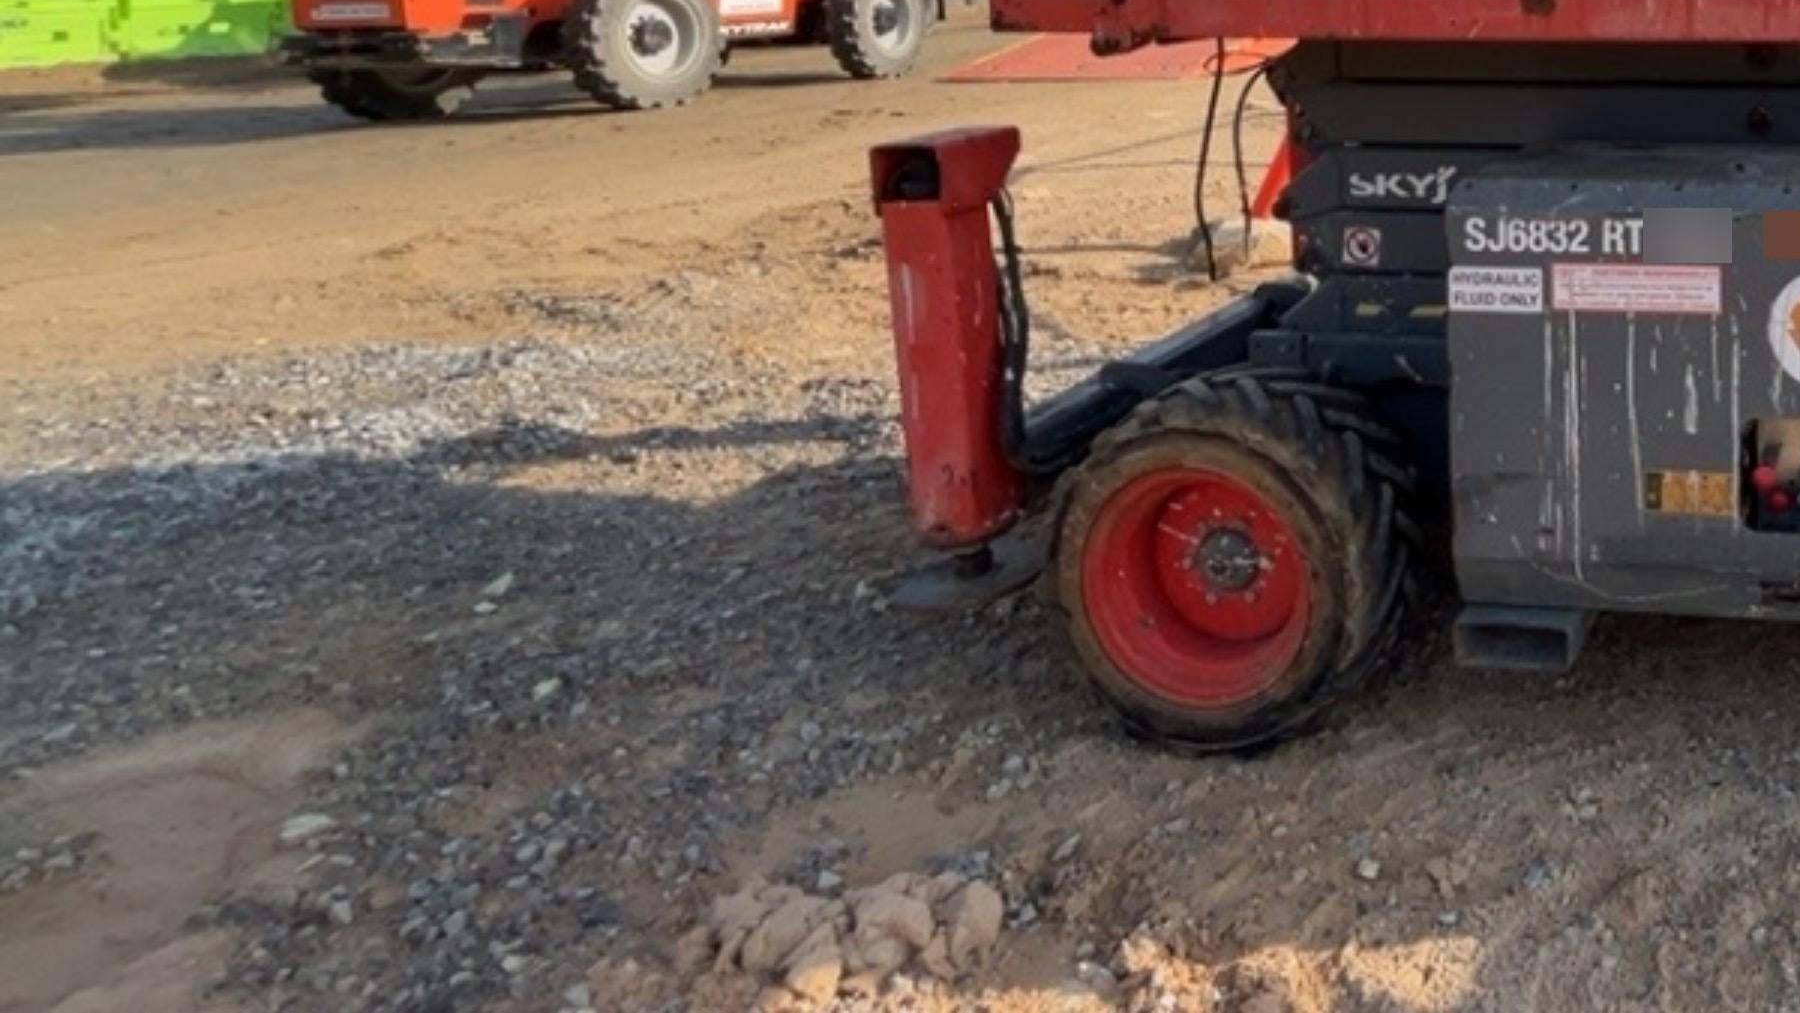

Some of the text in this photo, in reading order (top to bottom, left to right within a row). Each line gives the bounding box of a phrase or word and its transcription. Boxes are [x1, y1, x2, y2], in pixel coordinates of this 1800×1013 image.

[1463, 217, 1644, 254] SJ6832 RT
[1451, 271, 1538, 288] HYDRAULIC
[1454, 290, 1539, 307] FLUID ONLY
